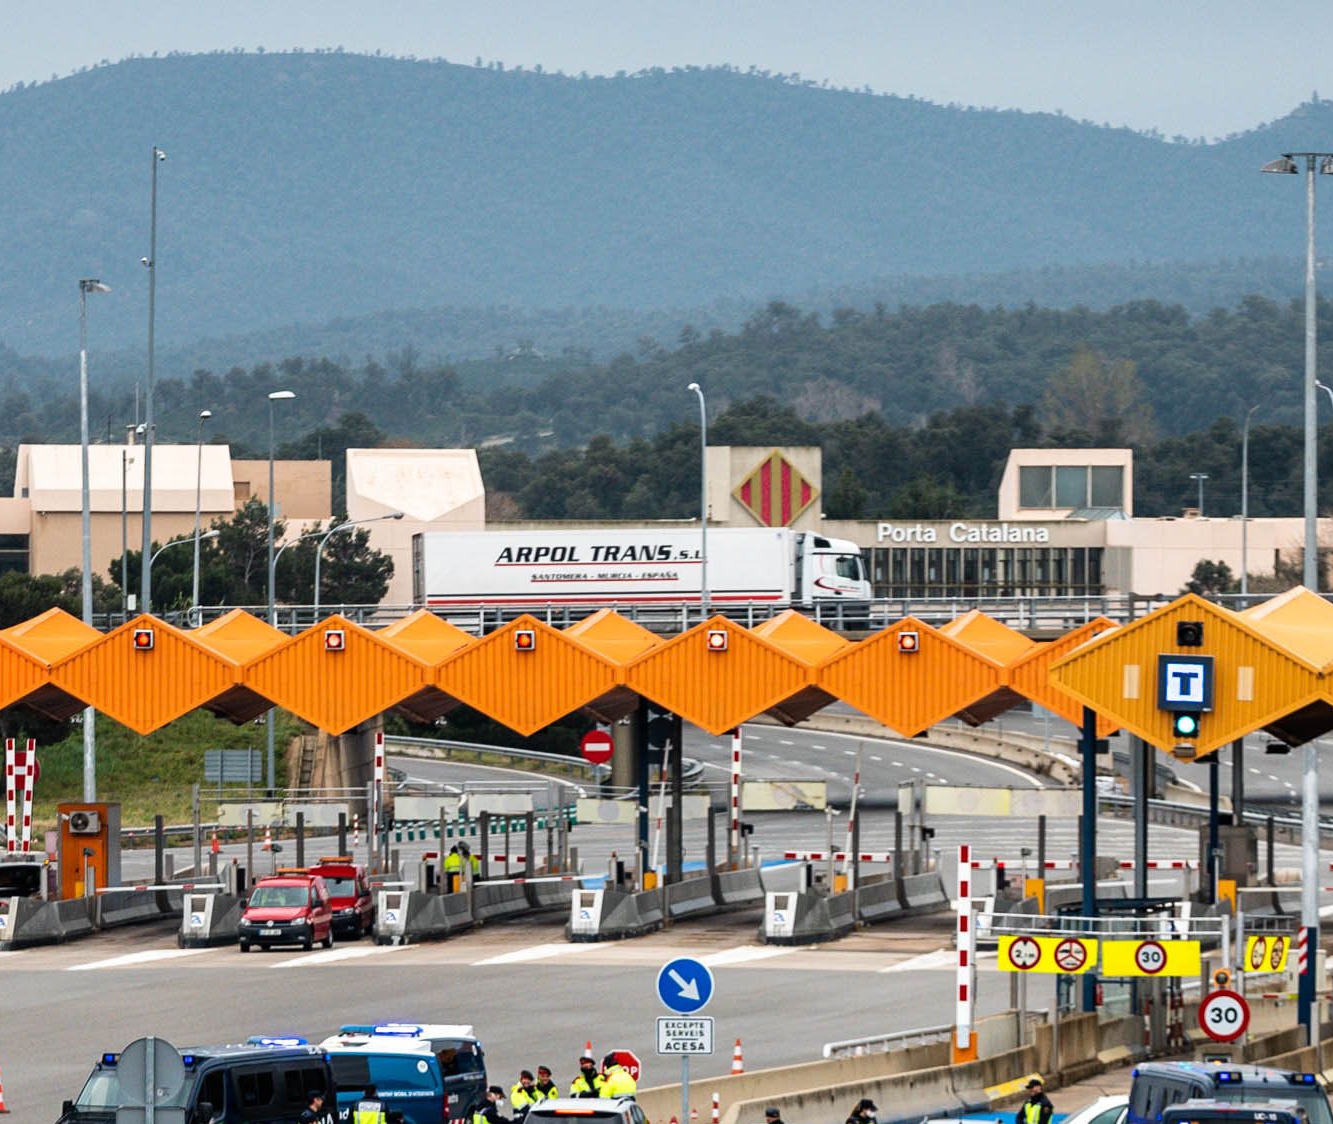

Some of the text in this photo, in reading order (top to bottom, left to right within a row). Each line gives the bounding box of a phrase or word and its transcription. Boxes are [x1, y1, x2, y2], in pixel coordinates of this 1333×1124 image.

[877, 522, 1049, 542] Porta Catalana
[496, 546, 580, 562] ARPOL
[1172, 671, 1199, 696] T
[1142, 951, 1161, 963] 30
[1211, 1007, 1238, 1024] 30
[665, 1042, 705, 1051] ACESA
